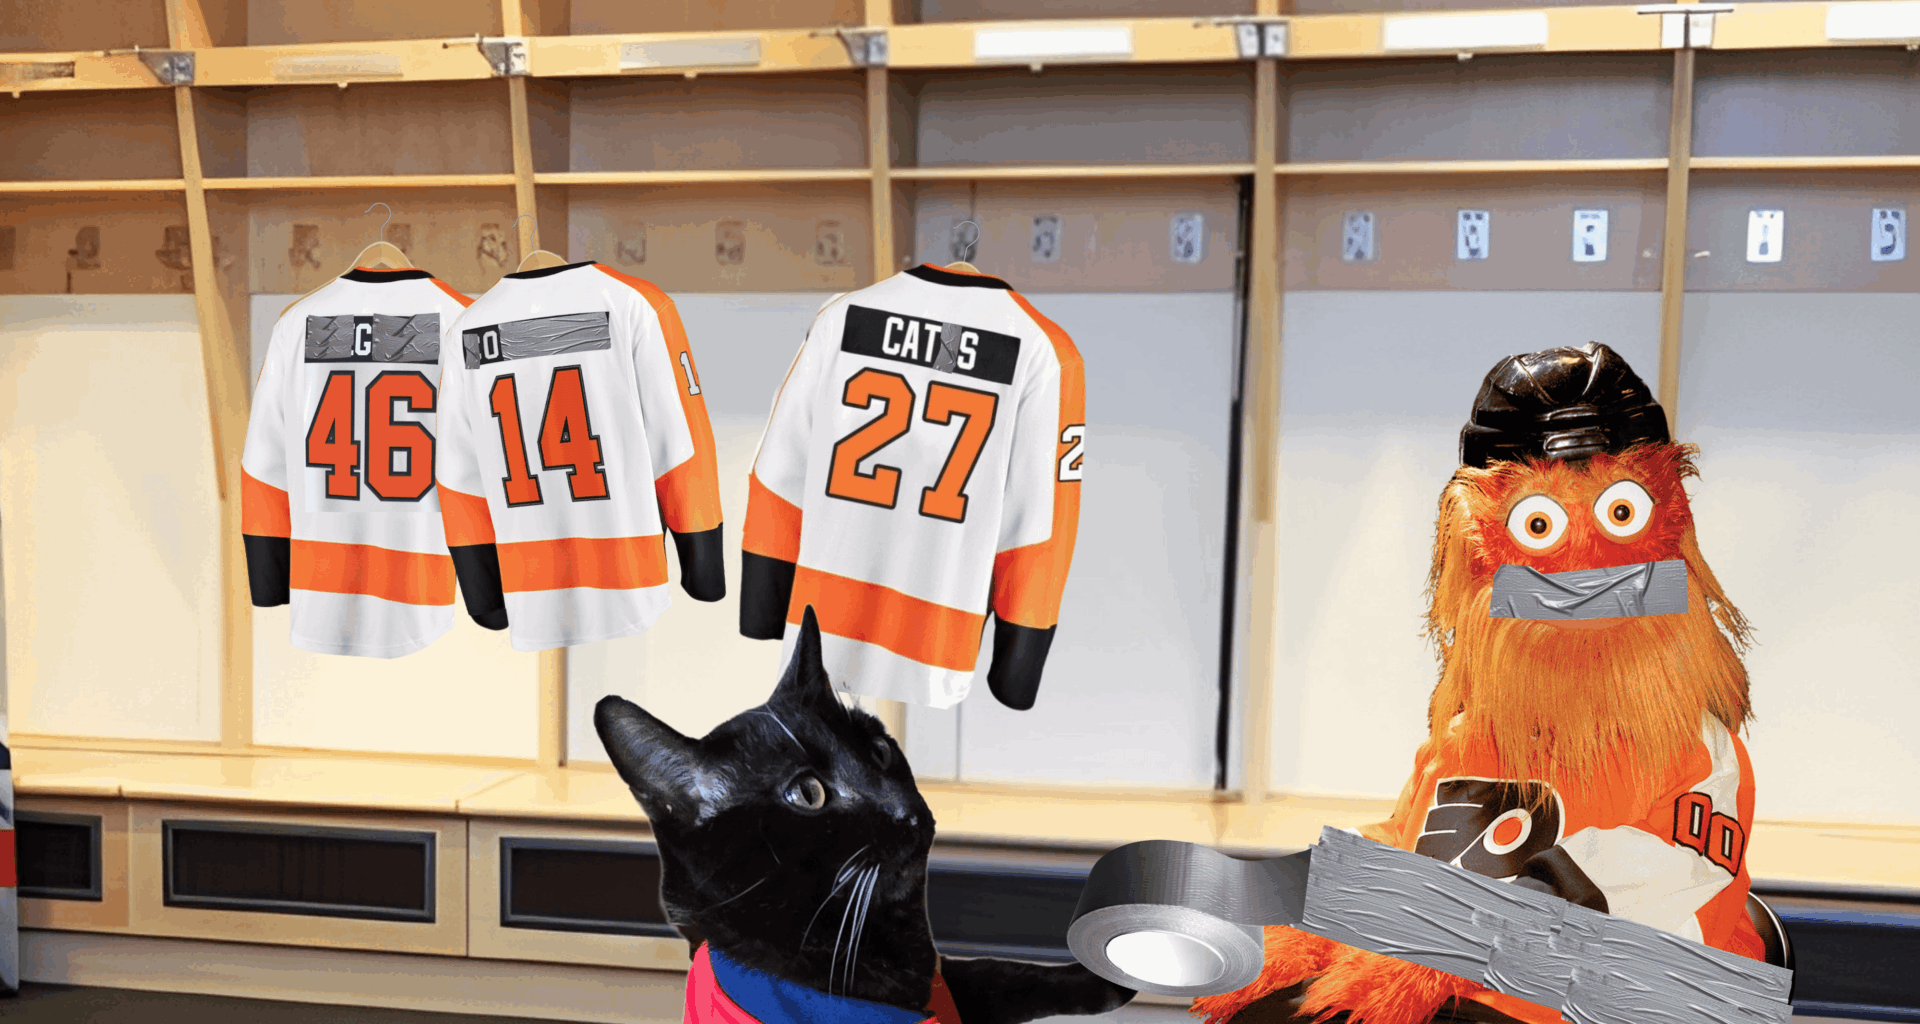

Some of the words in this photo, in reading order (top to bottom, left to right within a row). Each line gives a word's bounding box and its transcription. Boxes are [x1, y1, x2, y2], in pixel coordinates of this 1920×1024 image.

[351, 323, 372, 356] G
[304, 370, 437, 502] 46
[489, 364, 611, 508] 14
[825, 366, 999, 524] 27
[1672, 791, 1745, 877] 00
